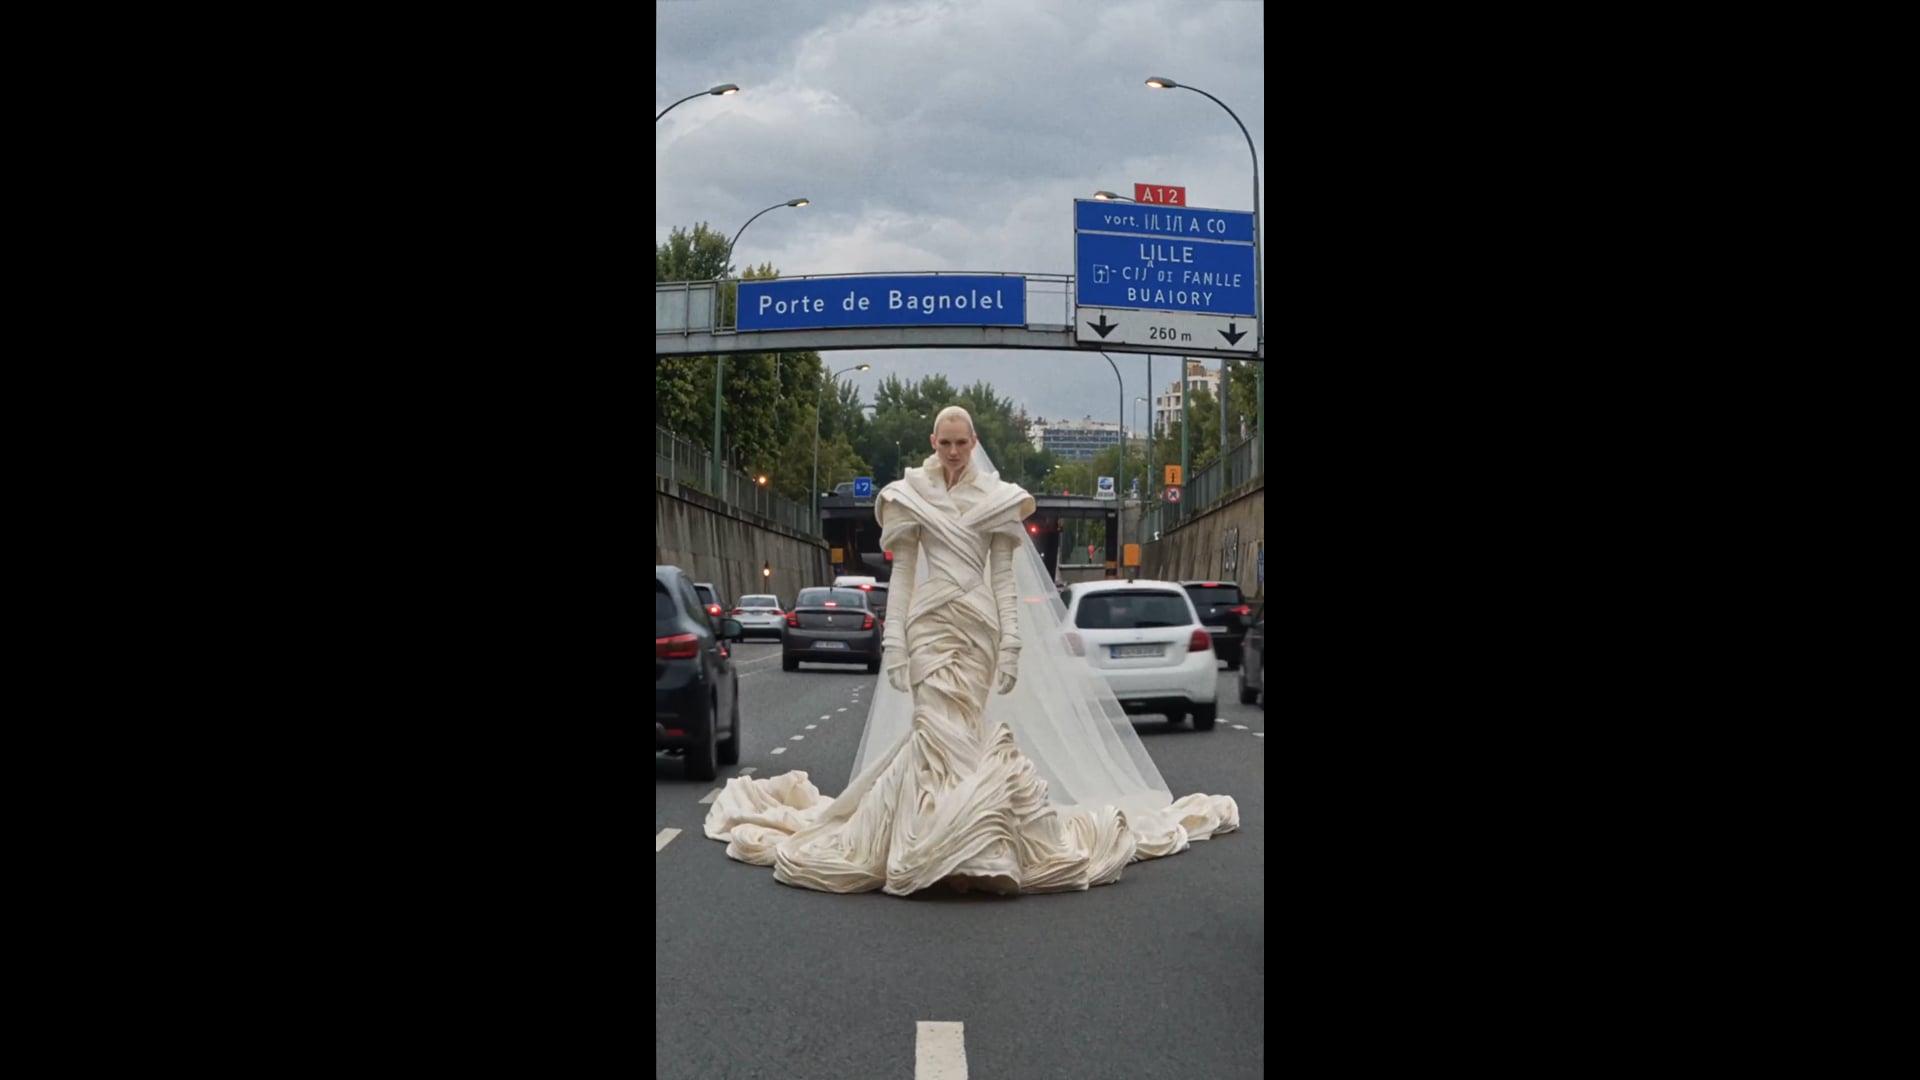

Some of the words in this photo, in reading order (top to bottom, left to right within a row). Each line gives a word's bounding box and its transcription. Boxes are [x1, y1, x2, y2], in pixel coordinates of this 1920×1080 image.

[1143, 187, 1178, 204] A12
[1140, 243, 1194, 264] LILLE
[759, 295, 825, 316] Porte
[842, 291, 870, 311] de
[1127, 287, 1213, 307] BUAIORY
